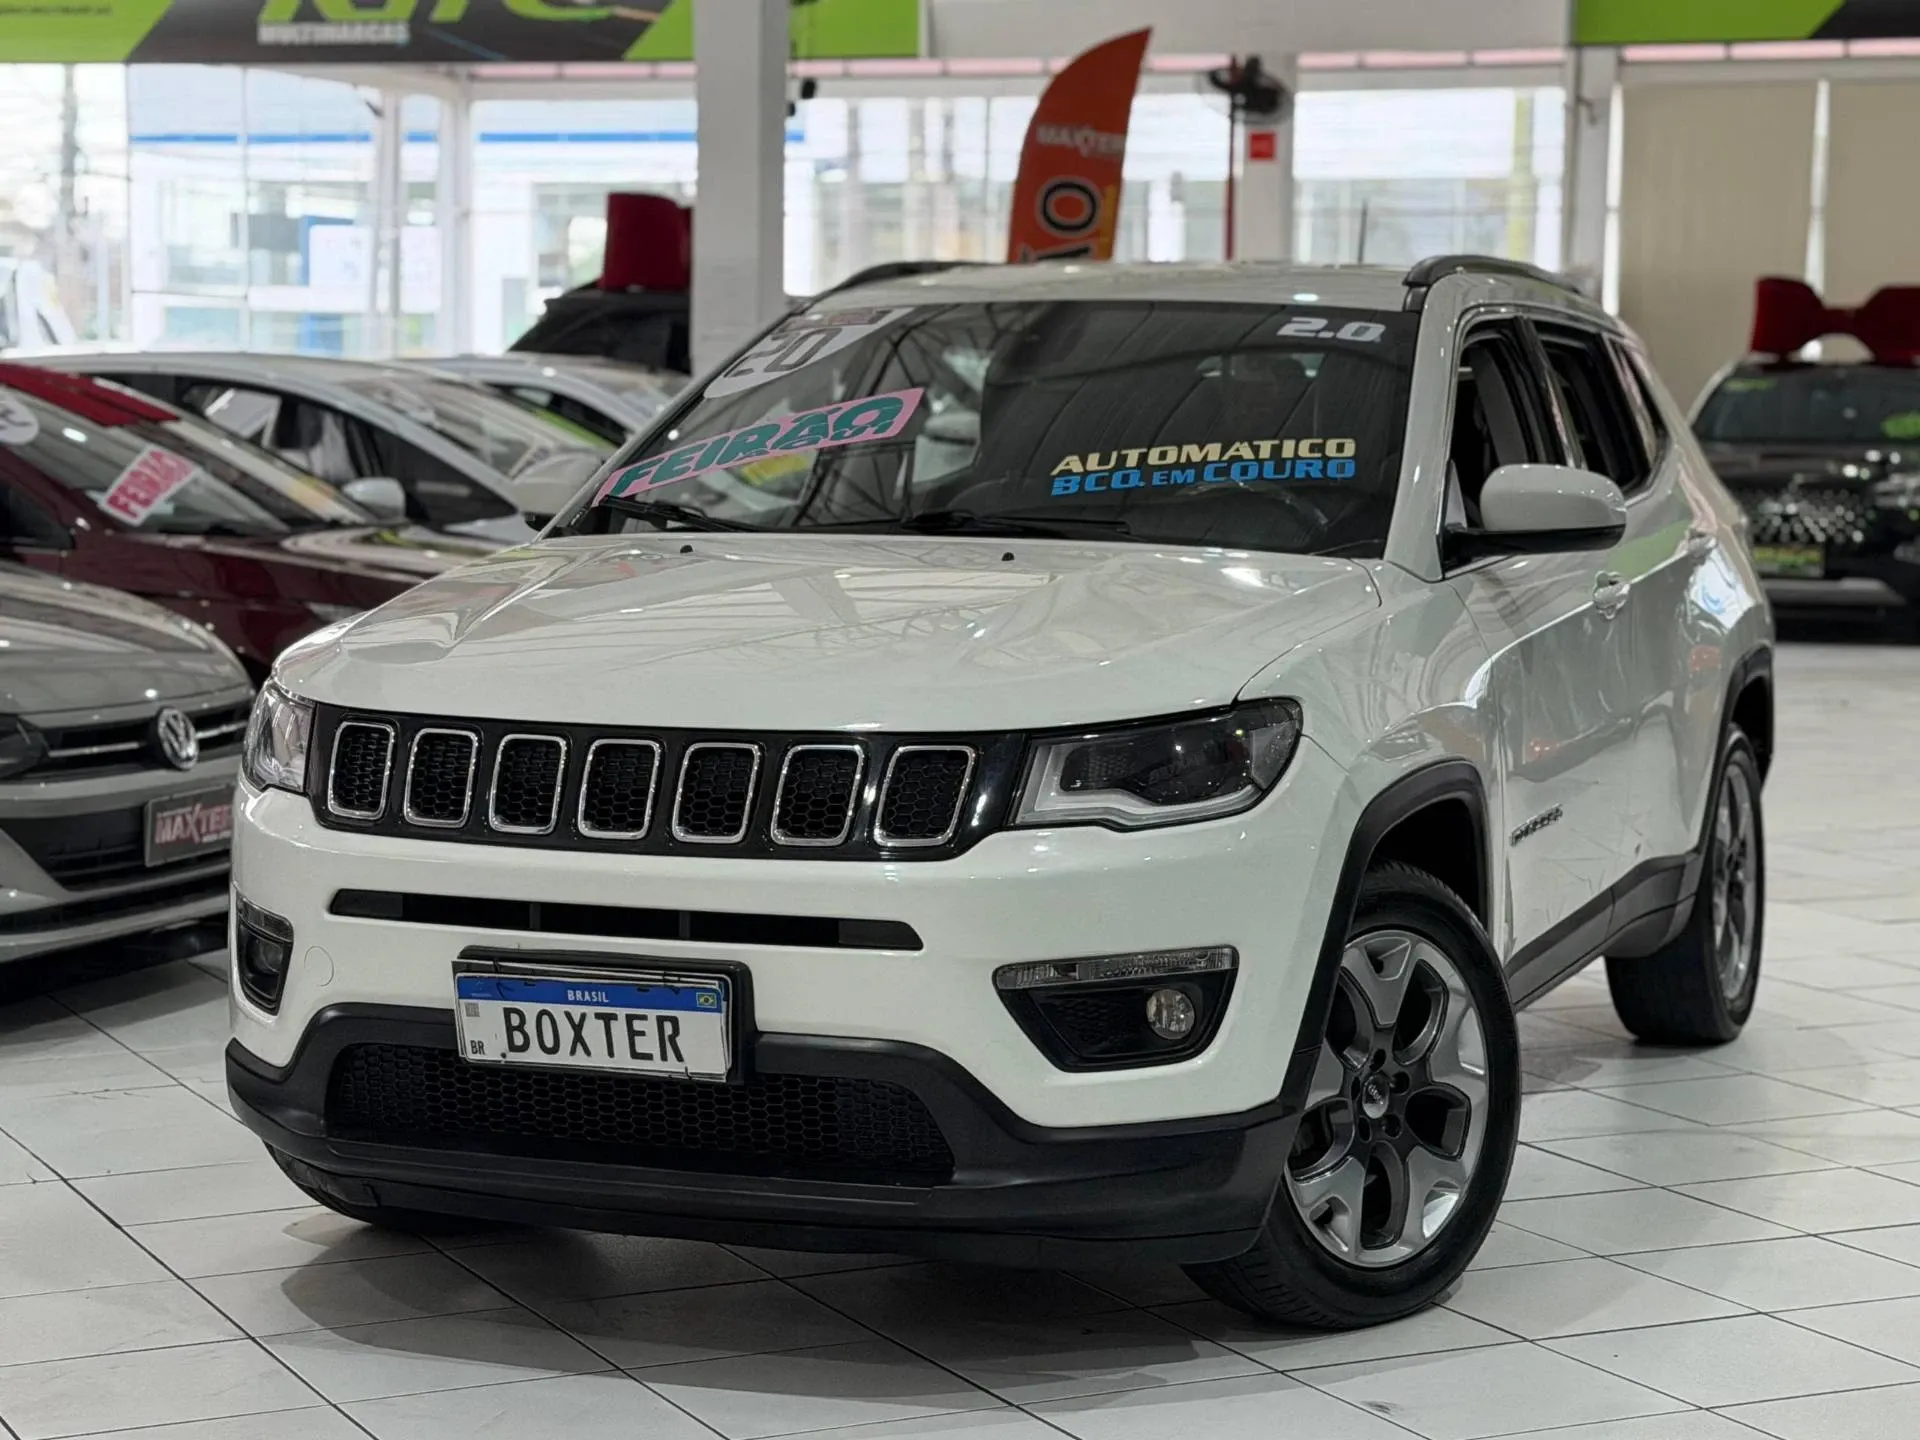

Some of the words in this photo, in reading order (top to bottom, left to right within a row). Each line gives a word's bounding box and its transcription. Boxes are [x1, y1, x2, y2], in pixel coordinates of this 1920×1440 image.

[1276, 316, 1387, 342] 2.0
[1152, 468, 1195, 486] EM
[1203, 459, 1356, 483] COURO
[567, 989, 610, 1004] BRASIL
[469, 1039, 486, 1056] BR
[502, 1006, 684, 1063] BOXTER
